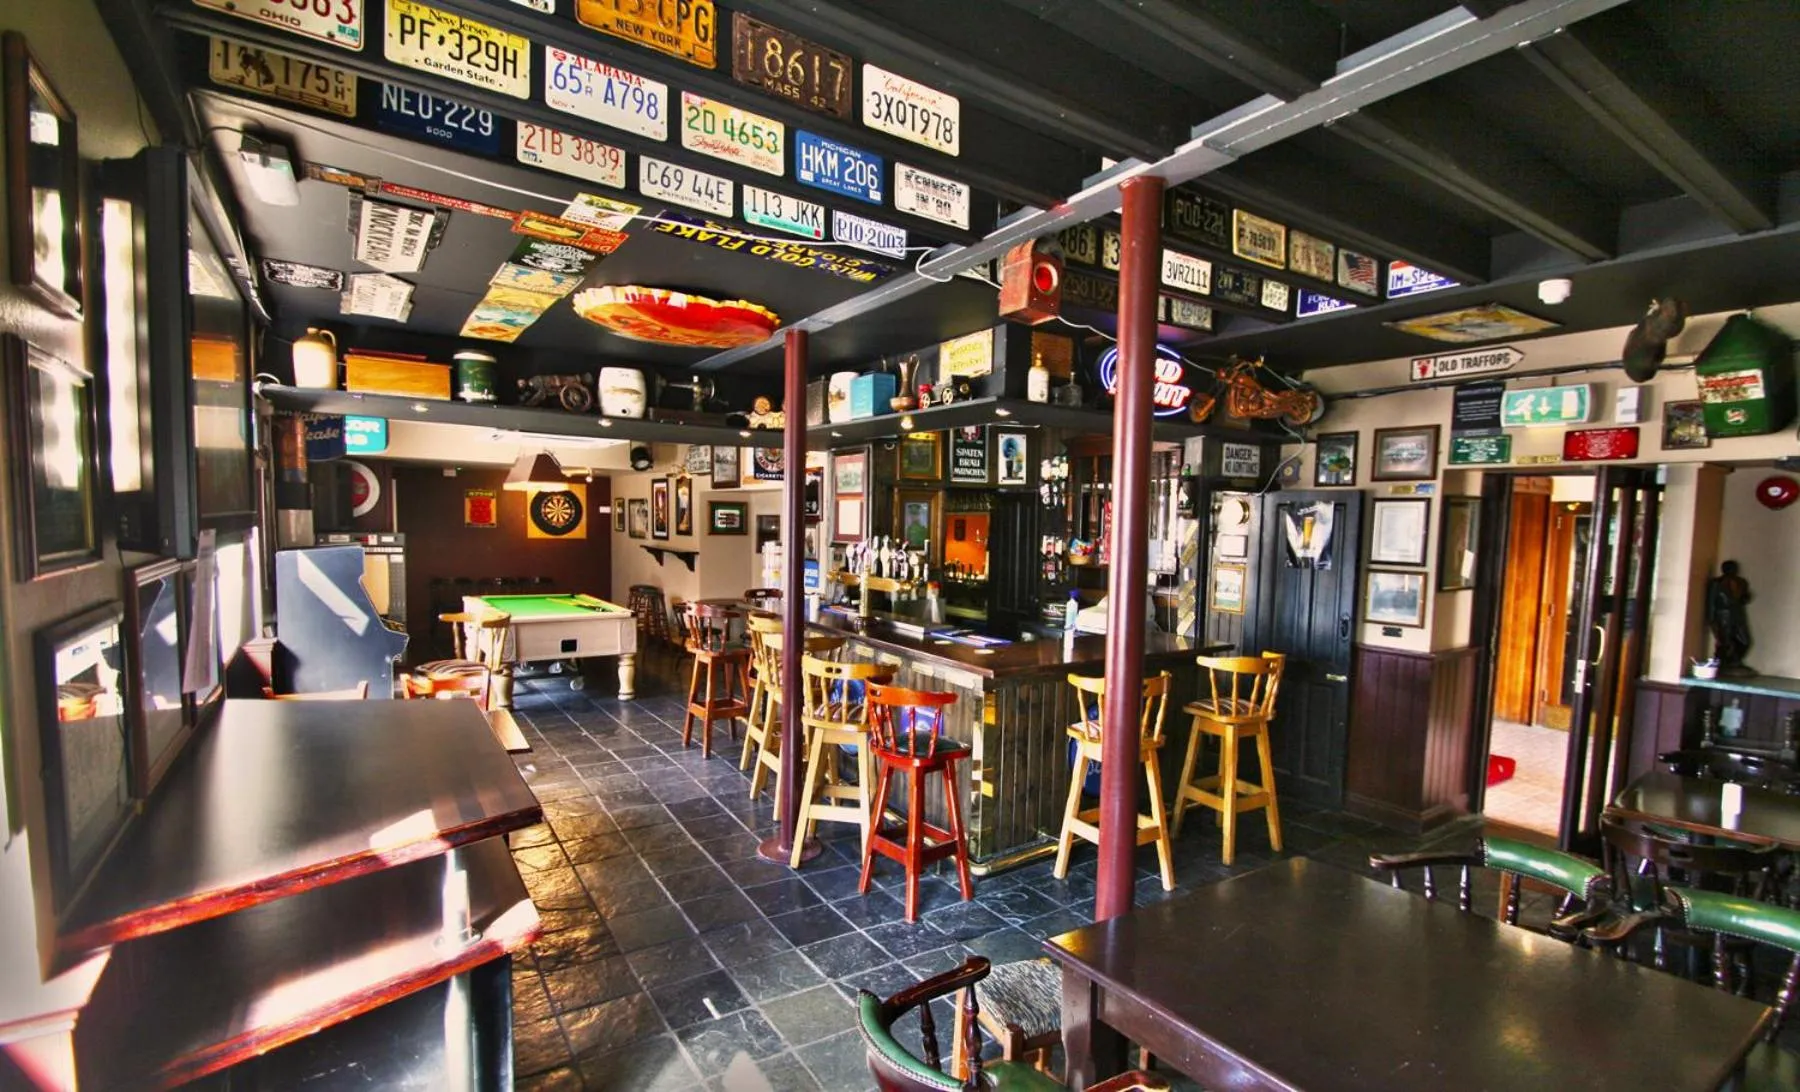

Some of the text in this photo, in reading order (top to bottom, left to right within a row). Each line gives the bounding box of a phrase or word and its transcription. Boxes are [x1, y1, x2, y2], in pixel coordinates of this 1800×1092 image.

[259, 8, 302, 26] OHIO
[429, 9, 491, 37] New Jersey
[616, 18, 682, 47] NEW YORK
[424, 57, 496, 86] Garden State
[574, 55, 643, 87] ALABAMA
[744, 29, 846, 101] 18617
[604, 78, 660, 120] A798
[764, 77, 800, 100] MASS
[883, 75, 940, 105] California
[524, 124, 620, 171] 21B 3839
[723, 117, 779, 154] 4653
[821, 141, 861, 158] MICHIGAN
[801, 143, 839, 178] HKM
[844, 157, 878, 189] 206
[647, 161, 727, 204] C69 44E
[751, 189, 782, 218] 113
[791, 201, 820, 228] JKK
[656, 220, 746, 253] FLAKE
[750, 243, 816, 270] GOLD
[1438, 359, 1458, 373] OLD
